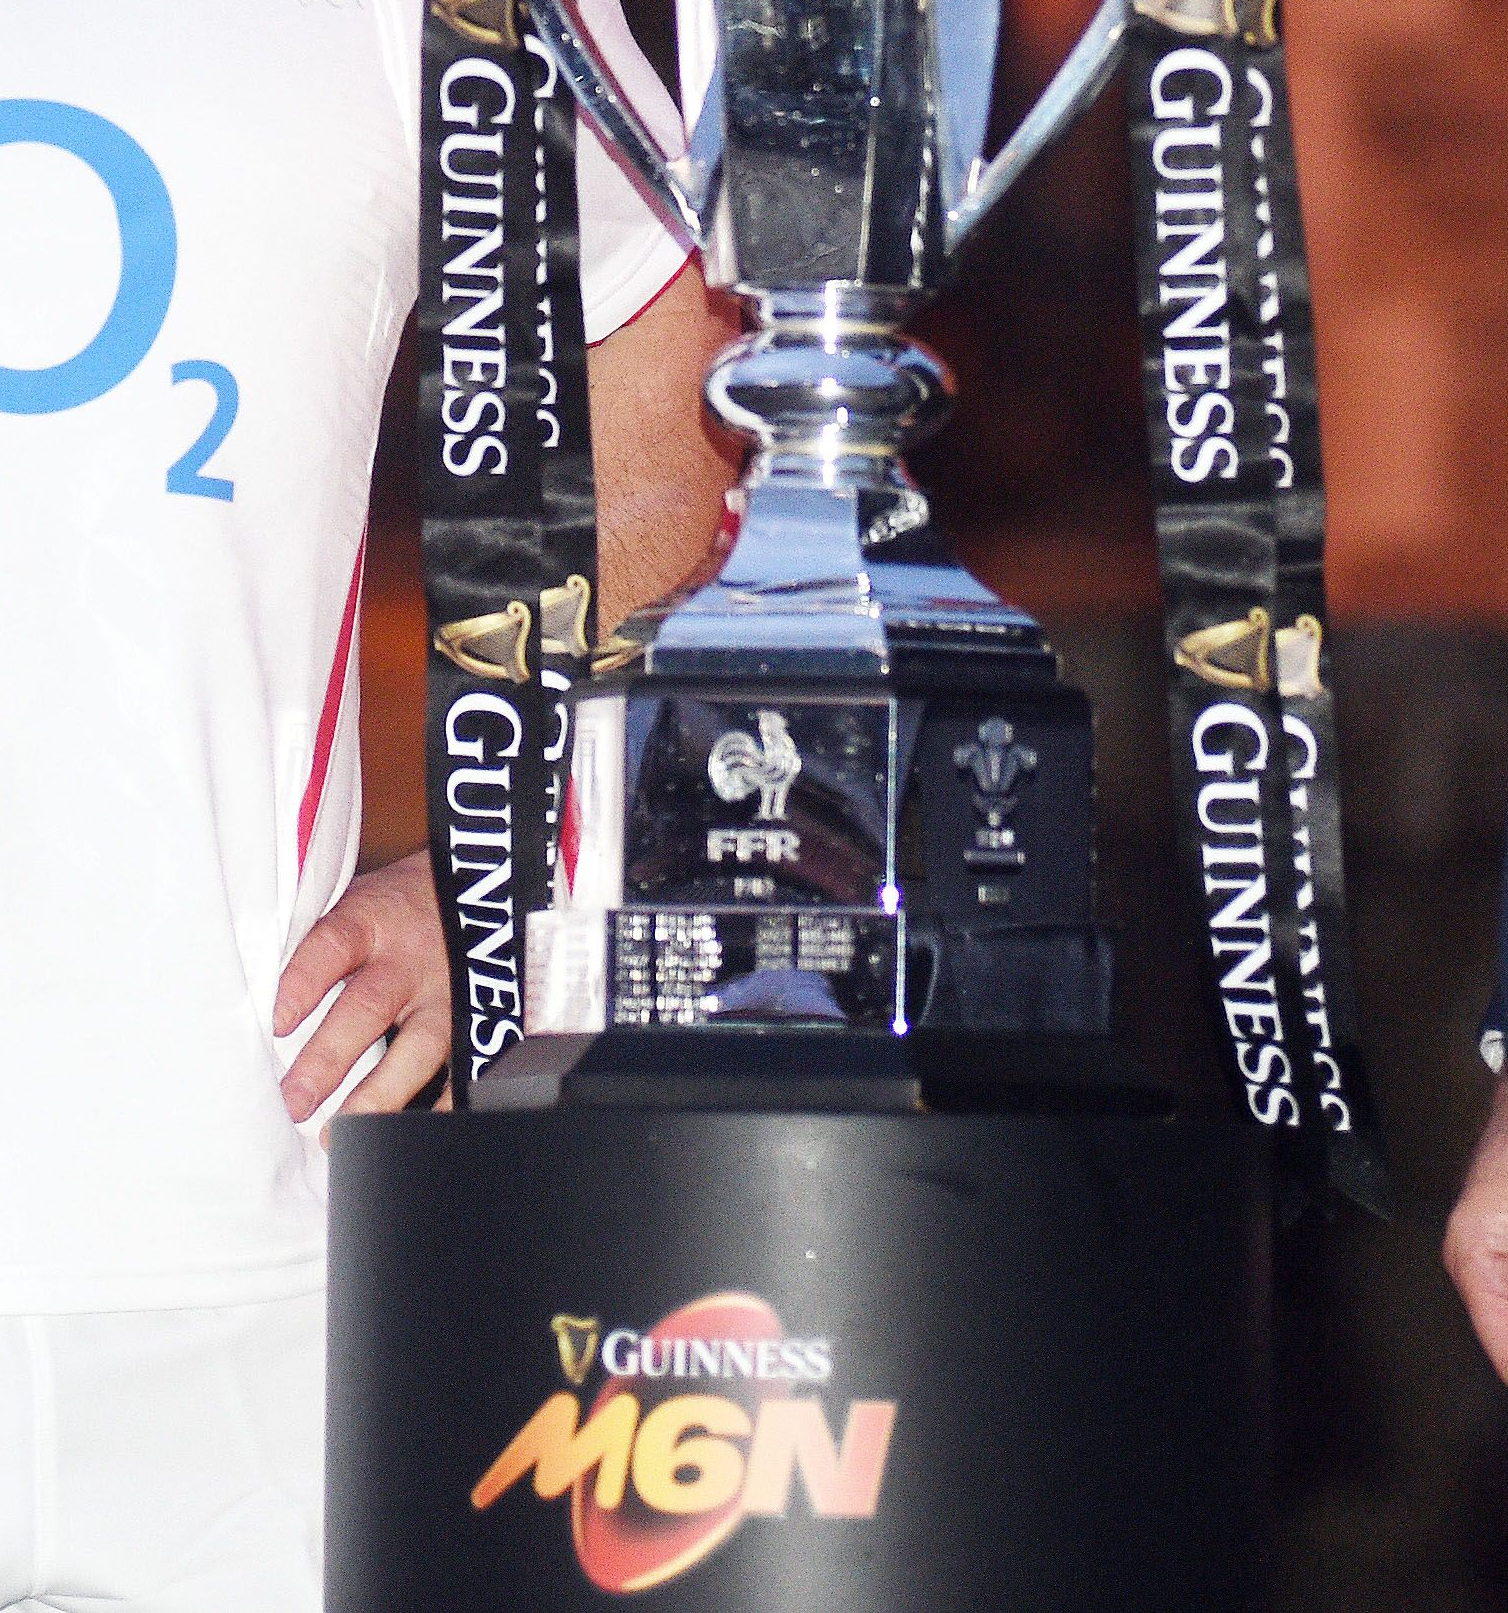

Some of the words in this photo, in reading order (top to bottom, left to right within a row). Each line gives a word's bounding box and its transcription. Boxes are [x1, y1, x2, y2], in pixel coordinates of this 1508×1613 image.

[439, 56, 516, 478] GUINNESS
[1150, 47, 1239, 484] GUINNESS
[445, 692, 524, 1083] GUINNES
[706, 828, 801, 862] FFR
[1192, 702, 1300, 1128] GUINNESS
[600, 1328, 834, 1382] GUINNESS
